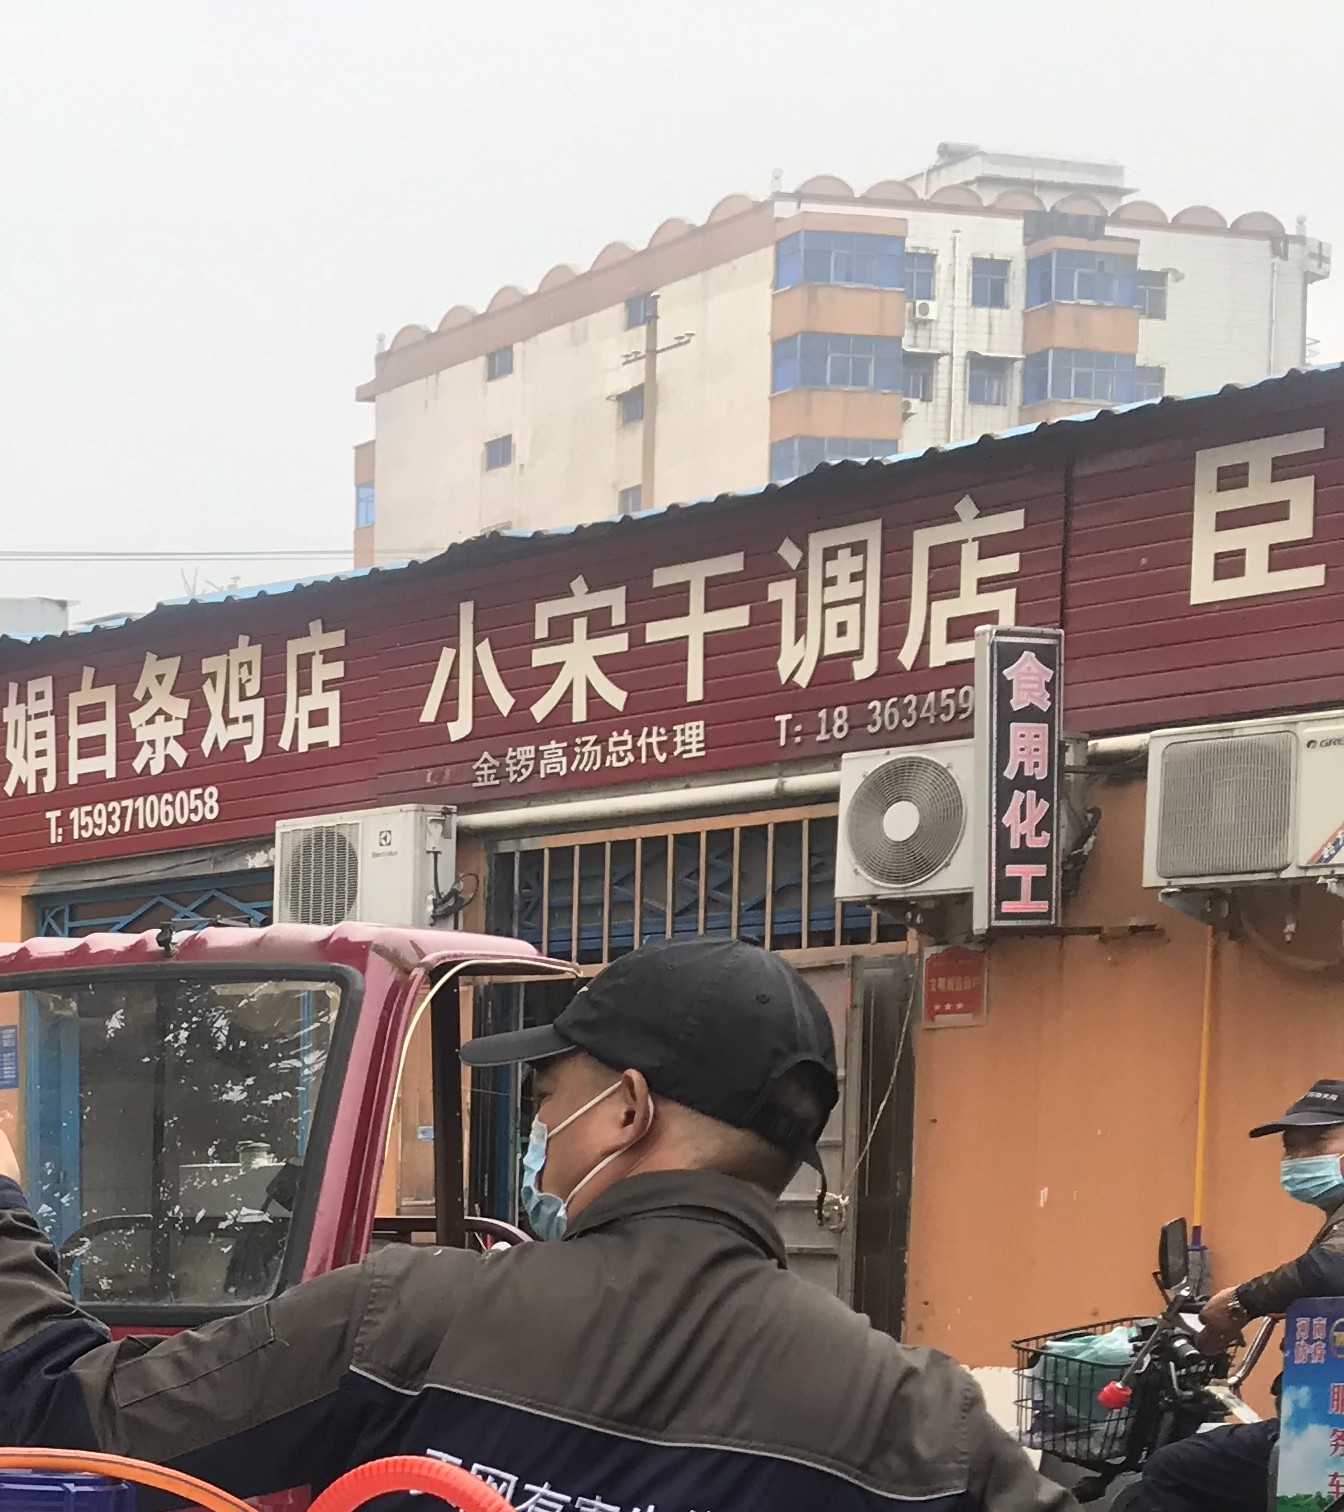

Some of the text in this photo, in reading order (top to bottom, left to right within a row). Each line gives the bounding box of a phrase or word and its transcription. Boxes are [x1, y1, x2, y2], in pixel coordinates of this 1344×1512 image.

[1190, 427, 1326, 605] 臣
[419, 495, 1026, 742] 小宋干调店
[69, 786, 219, 840] 15937106058
[471, 720, 706, 788] 金锣高汤总代理
[1001, 650, 1054, 913] 食用化工
